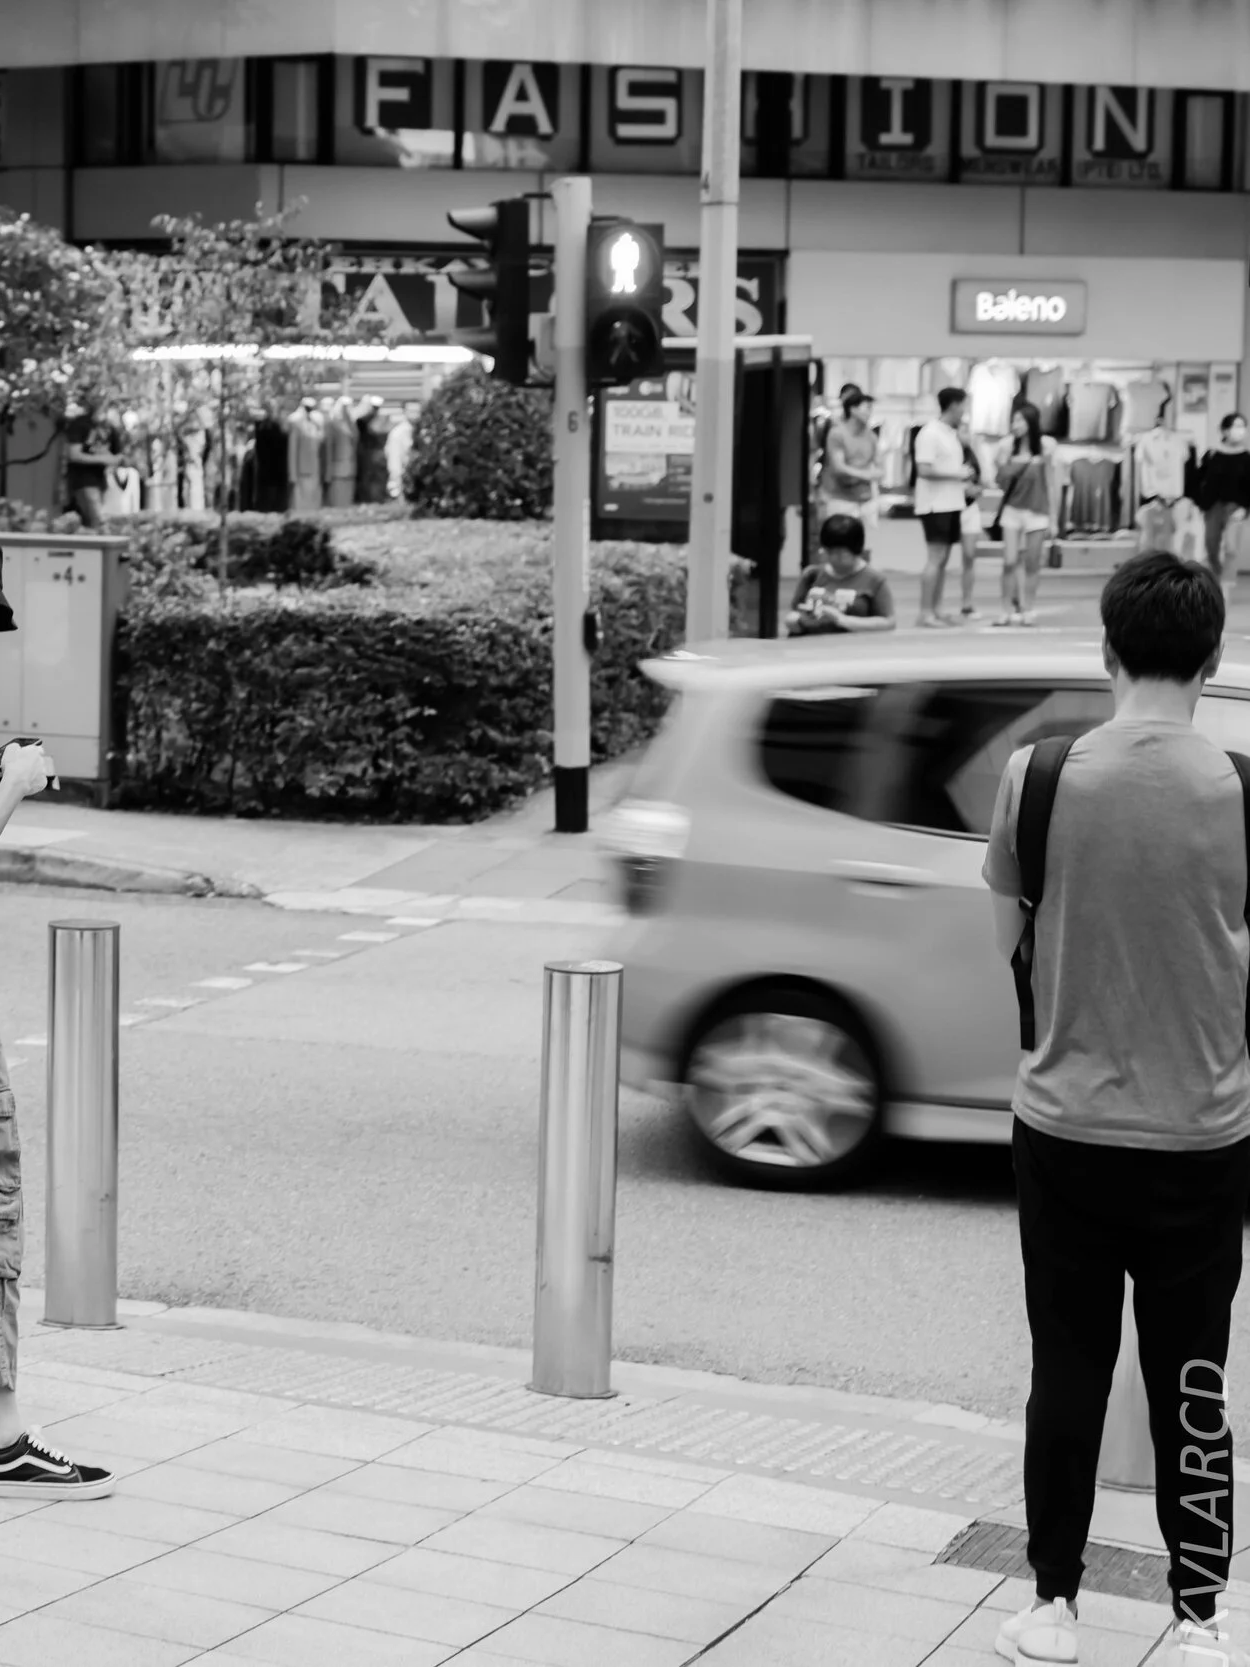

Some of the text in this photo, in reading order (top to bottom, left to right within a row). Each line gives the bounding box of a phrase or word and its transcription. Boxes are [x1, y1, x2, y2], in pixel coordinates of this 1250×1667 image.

[274, 272, 764, 338] TAIRS
[976, 288, 1067, 322] Baleno
[567, 410, 579, 433] 6
